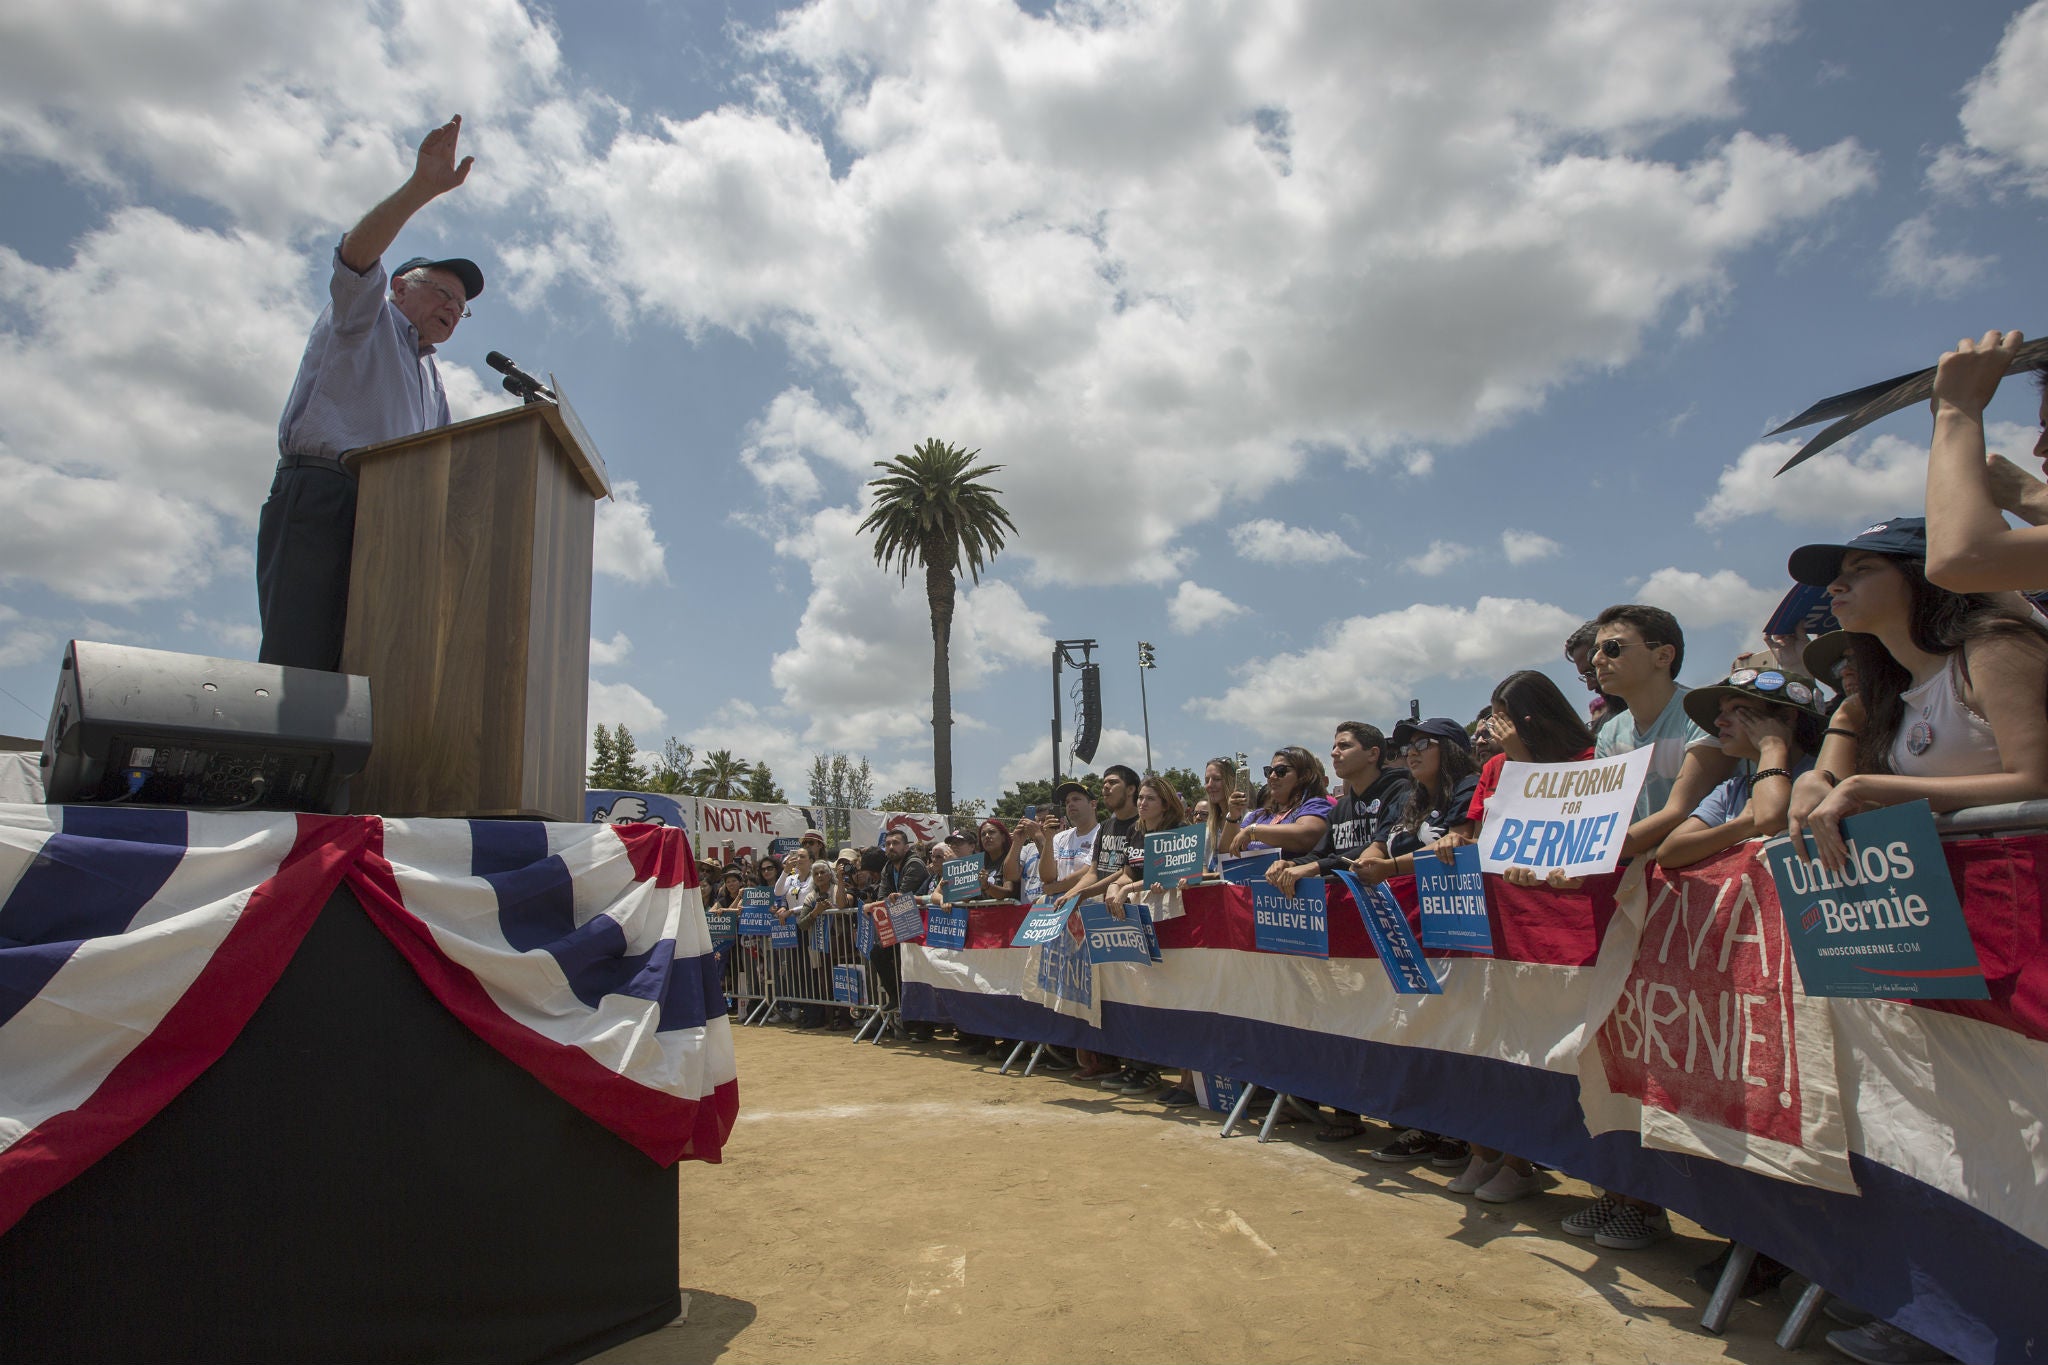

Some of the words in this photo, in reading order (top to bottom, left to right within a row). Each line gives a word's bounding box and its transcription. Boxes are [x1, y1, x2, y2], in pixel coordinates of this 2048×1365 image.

[1524, 762, 1627, 798] CALIFORNIA
[1561, 801, 1582, 815] FOR
[704, 805, 742, 832] NOT
[1153, 834, 1198, 854] Unidos
[1490, 811, 1620, 867] BERNIE!
[1128, 846, 1144, 859] Ber
[1164, 850, 1197, 867] Bernie
[947, 861, 979, 877] Unidos
[954, 872, 978, 886] Bernie
[1422, 876, 1430, 892] A
[1431, 873, 1471, 892] FUTURE
[1472, 873, 1482, 890] TO
[746, 890, 770, 899] Unidos
[750, 898, 770, 906] Bernie
[1256, 896, 1263, 907] A
[1264, 896, 1305, 912] FUTURE
[1308, 899, 1323, 913] TO
[1423, 896, 1477, 915] BELIEVE
[1477, 896, 1486, 916] IN
[1801, 908, 1821, 929] con
[1819, 886, 1930, 933] Bernie
[706, 914, 731, 923] nidos
[935, 917, 957, 926] FUTURE
[958, 919, 966, 927] TO
[1030, 916, 1061, 929] Bernie
[1257, 911, 1307, 930] BELIEVE
[1310, 916, 1325, 932] IN
[929, 925, 956, 935] BELIEVE
[957, 928, 965, 937] IN
[1023, 924, 1062, 941] Unidos
[1363, 886, 1403, 959] ELIEVE
[1399, 965, 1419, 989] IN
[1376, 890, 1413, 959] FUTURE
[1411, 963, 1428, 989] TO
[1090, 931, 1147, 954] Bernie
[1817, 942, 1921, 957] UNIDOSCONBERNIE.COM
[1043, 947, 1091, 993] BERNIE
